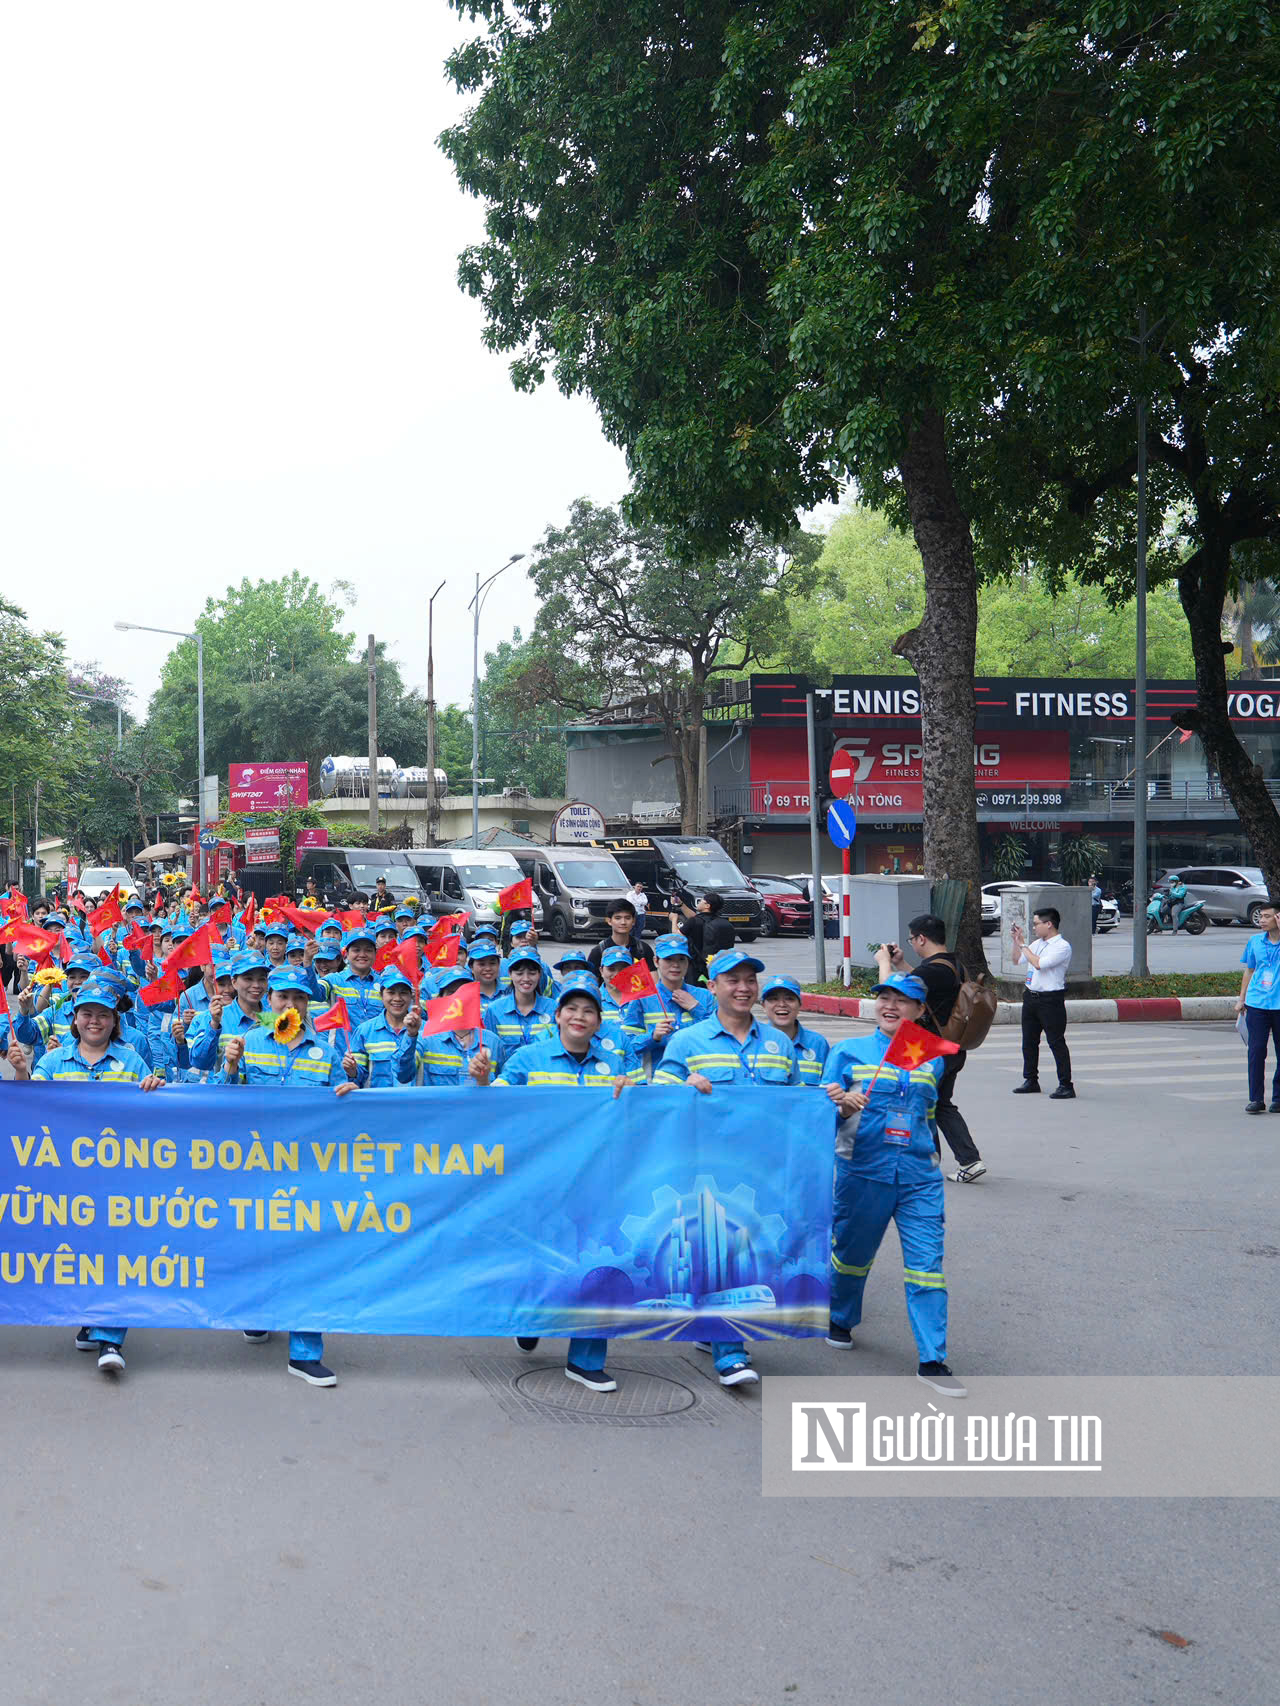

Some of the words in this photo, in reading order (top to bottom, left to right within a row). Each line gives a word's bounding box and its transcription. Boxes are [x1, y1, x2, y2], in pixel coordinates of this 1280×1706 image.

[1015, 692, 1128, 717] FITNESS
[885, 769, 920, 777] FITNESS
[776, 795, 790, 807] 69
[991, 794, 1062, 805] 0971.299.998
[569, 807, 591, 816] TOILET
[1009, 821, 1060, 830] WELCOME
[11, 1126, 61, 1168] VÀ
[72, 1127, 177, 1169] CÔNG
[189, 1131, 299, 1171] ĐOÀN
[311, 1133, 402, 1182] VIỆT
[414, 1144, 505, 1175] NAM
[108, 1187, 219, 1229] BƯỚC
[229, 1187, 321, 1232] TIẾN
[332, 1191, 411, 1233] VÀO
[118, 1245, 205, 1288] MỚI!
